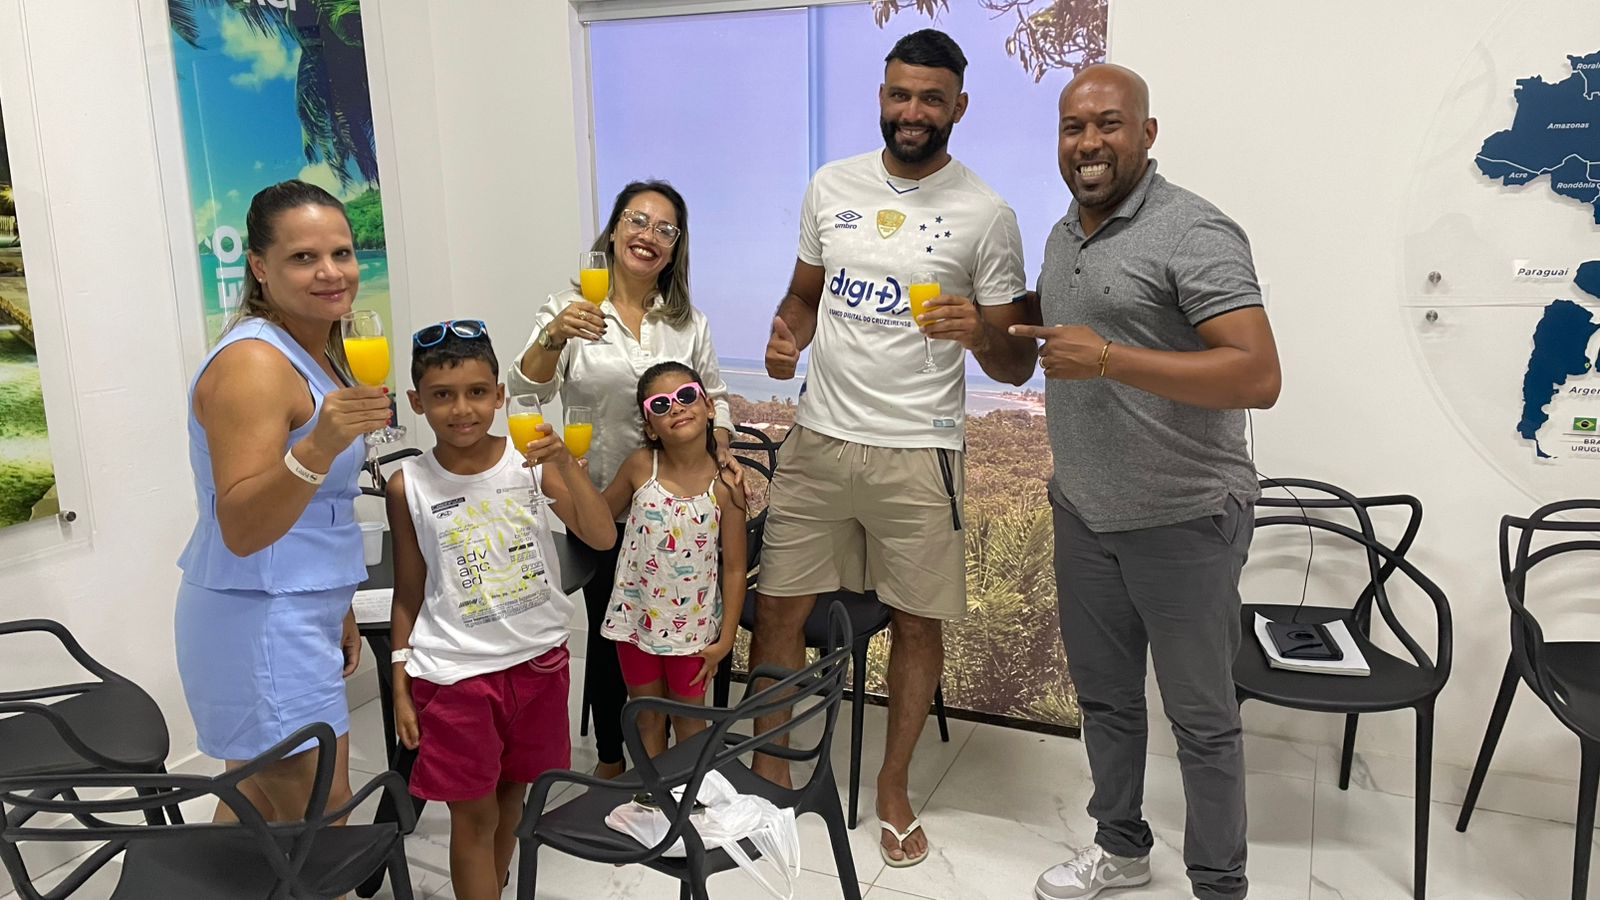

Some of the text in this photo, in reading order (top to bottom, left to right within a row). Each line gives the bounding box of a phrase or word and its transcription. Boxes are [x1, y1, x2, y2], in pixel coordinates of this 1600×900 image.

[1576, 62, 1600, 70] Rorai
[204, 225, 246, 324] EIÓ
[1517, 267, 1569, 278] Paraguai
[843, 311, 862, 321] DIGITAL
[862, 315, 871, 323] DO
[456, 549, 487, 566] adv
[461, 573, 482, 589] ed
